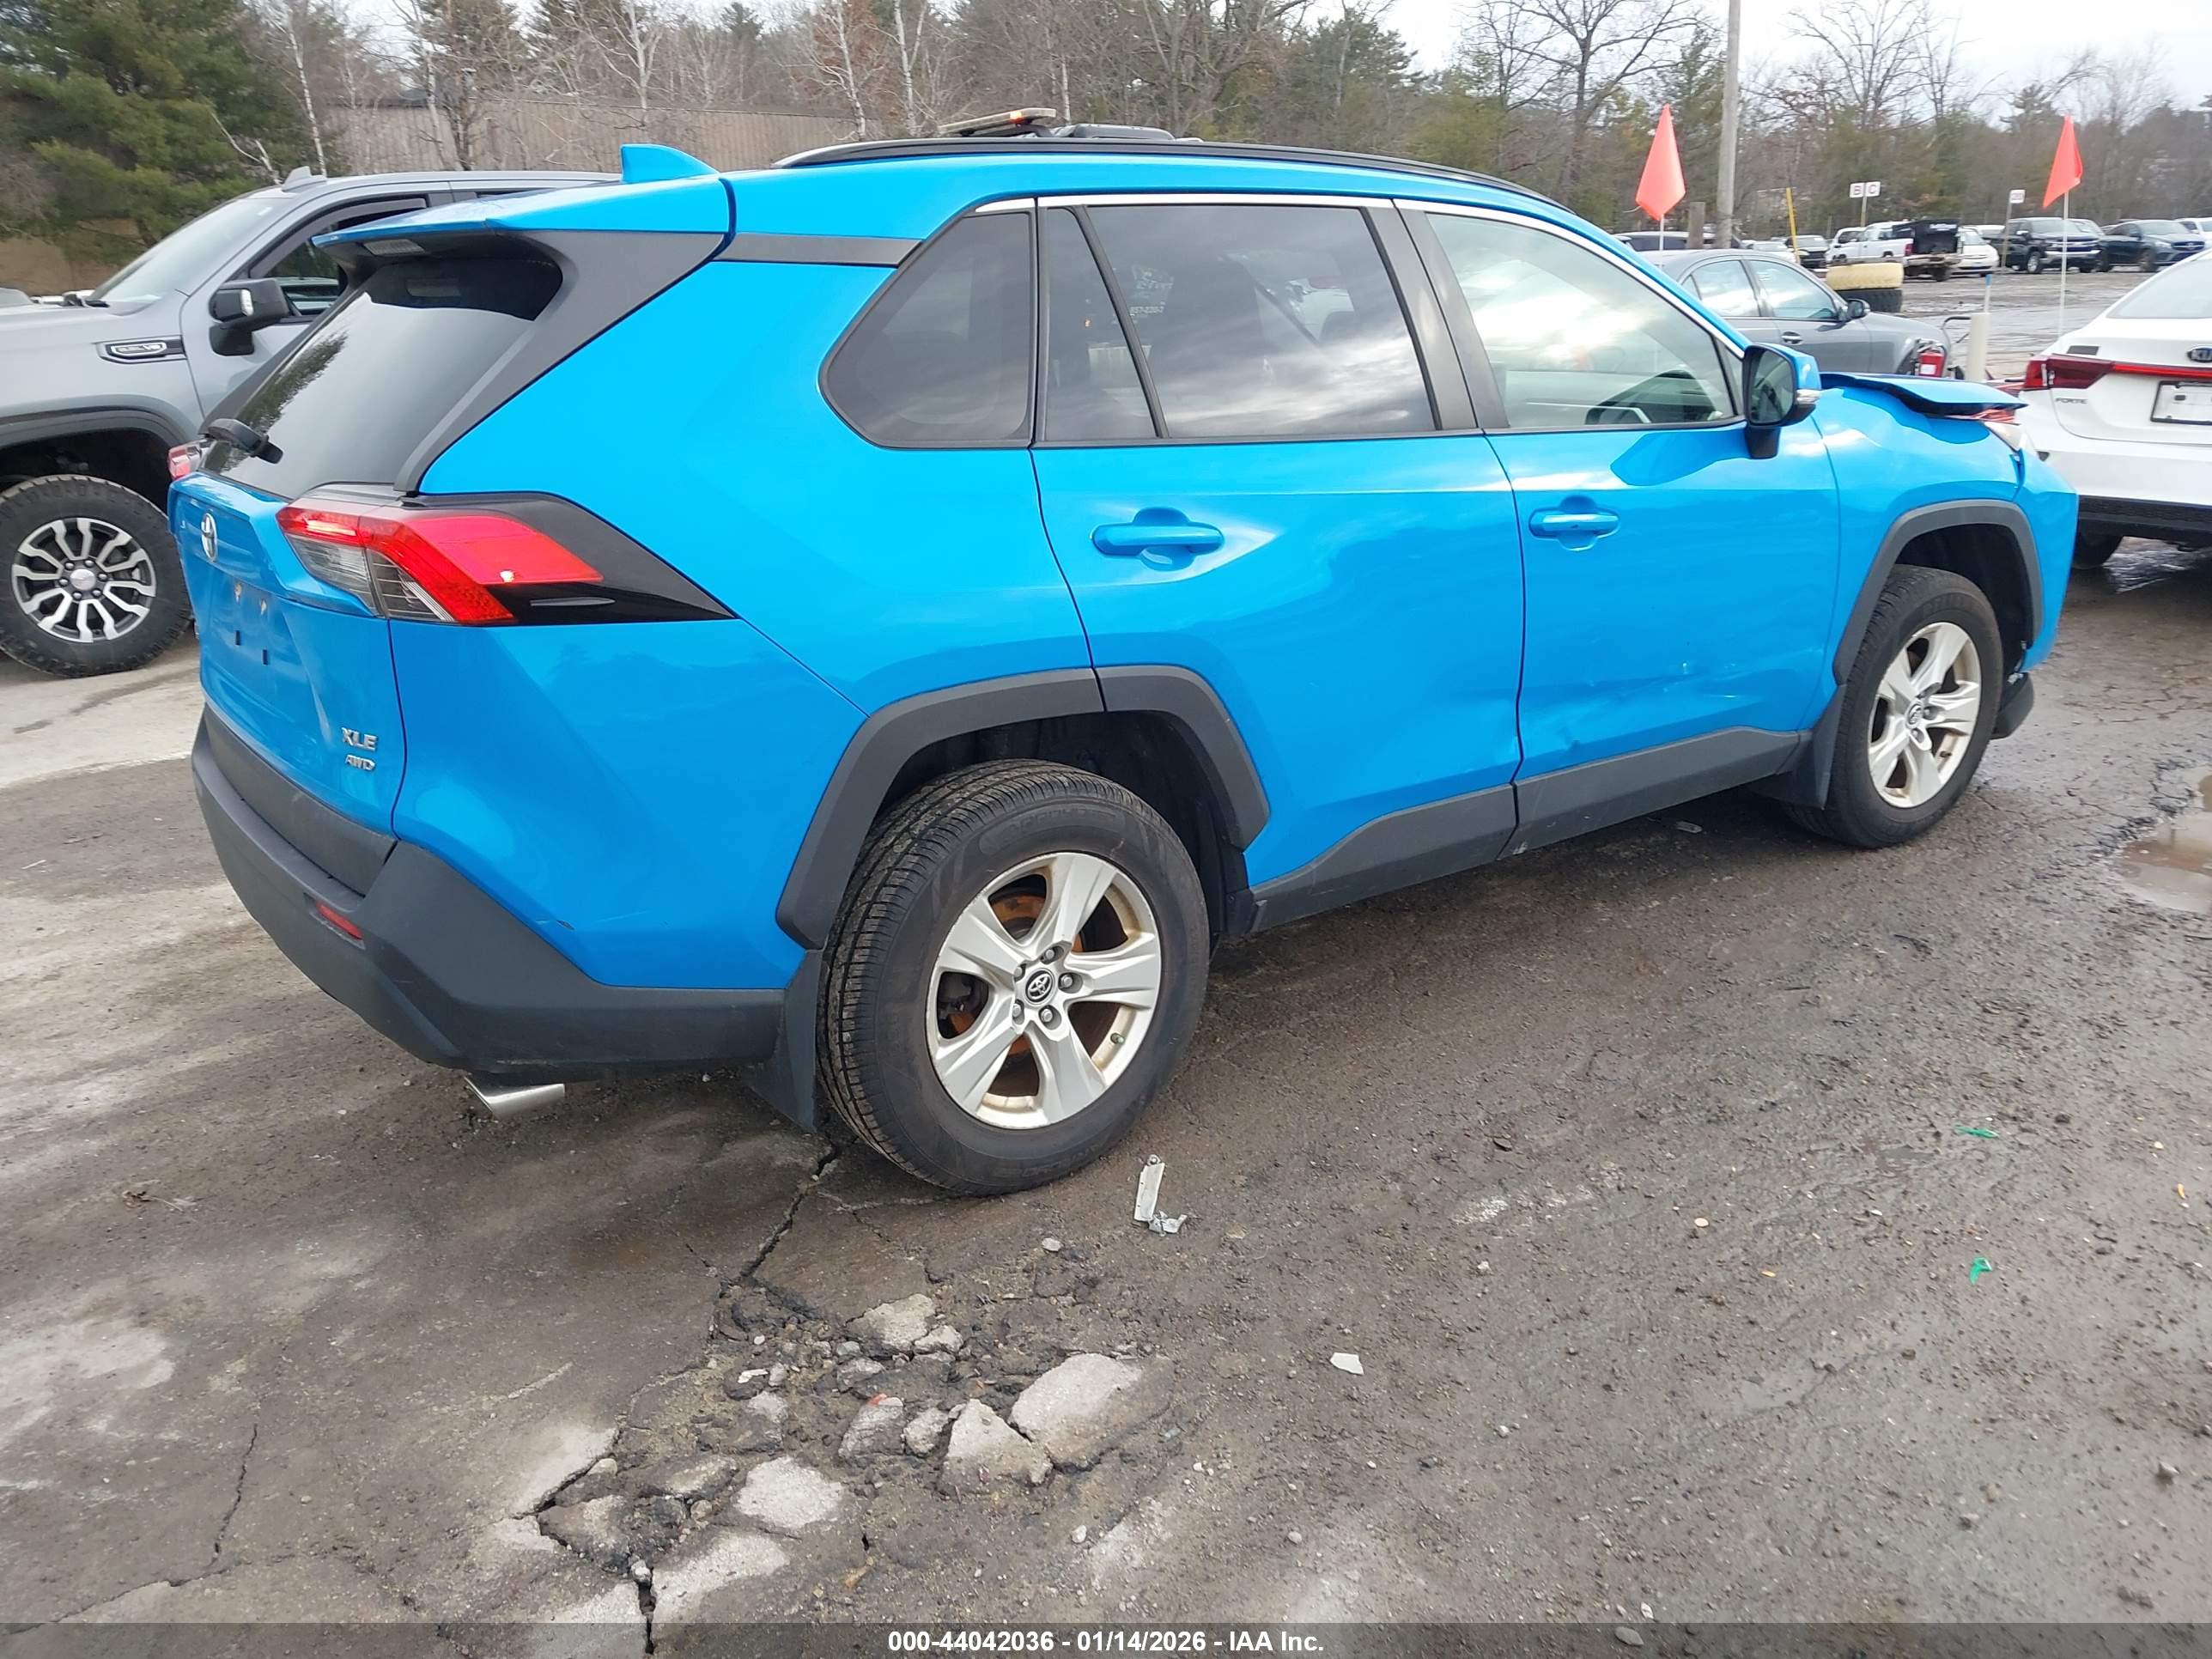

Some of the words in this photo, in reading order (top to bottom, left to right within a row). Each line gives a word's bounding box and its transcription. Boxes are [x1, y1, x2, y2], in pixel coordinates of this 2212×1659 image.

[1868, 184, 1877, 194] C
[341, 727, 379, 751] XLE
[344, 754, 376, 771] AWD
